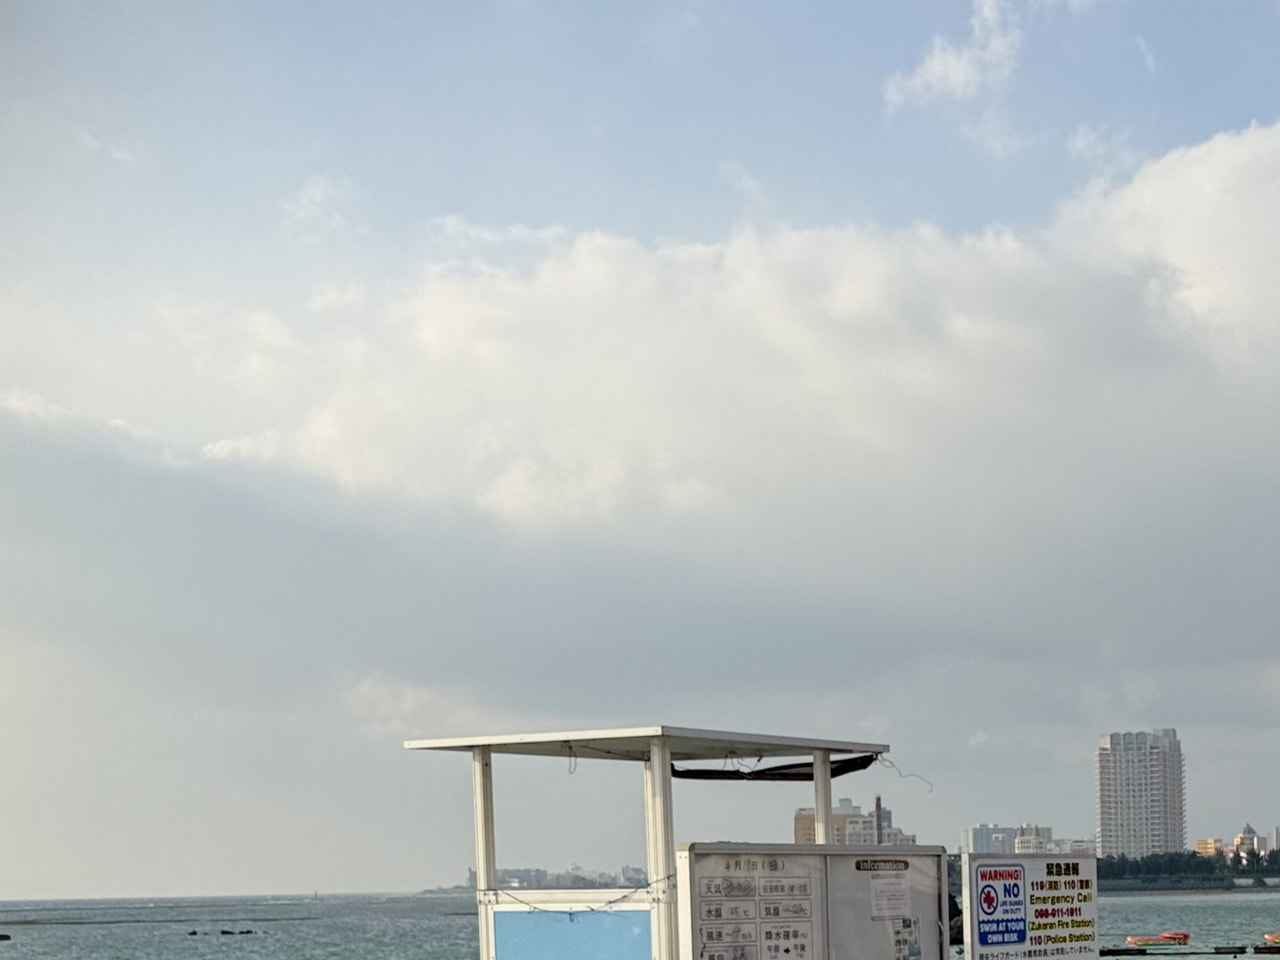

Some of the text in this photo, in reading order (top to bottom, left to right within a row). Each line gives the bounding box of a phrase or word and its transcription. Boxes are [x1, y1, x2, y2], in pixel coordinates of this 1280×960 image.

[980, 869, 1021, 881] WARNING!
[1003, 882, 1020, 898] NO
[1030, 892, 1092, 905] Emergency Call
[980, 921, 1024, 932] SWIM AT YOUR
[1058, 920, 1069, 929] Fire
[1071, 918, 1094, 928] Station)
[987, 933, 1018, 943] OWN RISK
[1068, 931, 1095, 943] Station)
